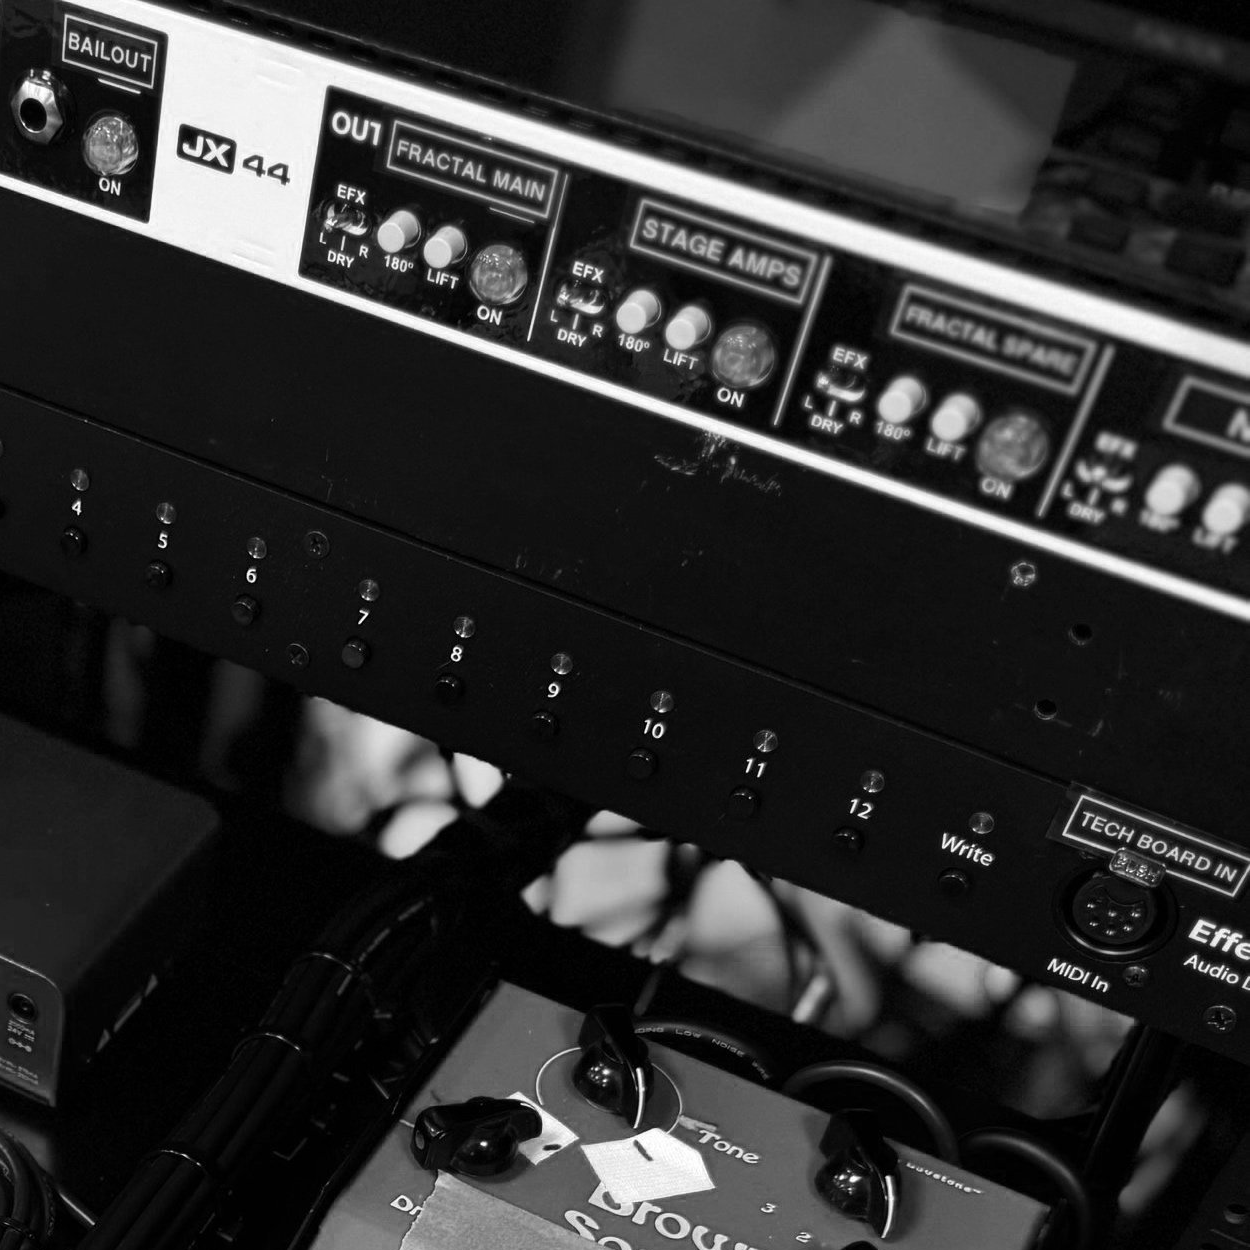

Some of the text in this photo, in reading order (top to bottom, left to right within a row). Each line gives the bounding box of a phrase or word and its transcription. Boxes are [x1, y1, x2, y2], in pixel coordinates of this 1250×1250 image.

[68, 32, 152, 72] BAILOUT
[331, 111, 383, 147] OUT
[181, 133, 291, 186] JX 44
[396, 139, 546, 201] FRACTAL MAIN
[99, 177, 121, 196] ON
[336, 184, 366, 205] EFX
[318, 233, 327, 245] L
[327, 249, 354, 269] DRY
[359, 246, 369, 258] R
[642, 218, 802, 288] STAGE AMPS
[427, 269, 459, 290] LIFT
[572, 262, 605, 283] EFX
[476, 306, 503, 325] ON
[550, 310, 558, 323] L
[557, 329, 587, 348] DRY
[593, 324, 604, 338] R
[904, 302, 1078, 376] FRACTAL SPARE
[663, 349, 699, 370] LIFT
[833, 346, 868, 370] EFX
[717, 387, 745, 407] ON
[811, 415, 844, 435] DRY
[926, 437, 967, 461] LIFT
[983, 476, 1012, 499] ON
[71, 500, 83, 516] 4
[1068, 502, 1105, 524] DRY
[158, 533, 169, 549] 5
[246, 567, 257, 584] 6
[357, 609, 370, 626] 7
[450, 646, 462, 663] 8
[548, 682, 560, 699] 9
[643, 718, 665, 740] 10
[745, 757, 767, 780] 11
[849, 798, 873, 820] 12
[940, 832, 996, 866] Write
[1082, 811, 1239, 882] TECH BOARD IN
[1047, 957, 1110, 993] MIDI In
[1183, 954, 1239, 984] Audio
[676, 1028, 746, 1057] LOW NOISE
[699, 1129, 762, 1164] Tone
[760, 1203, 778, 1213] 3
[795, 1232, 812, 1243] 2
